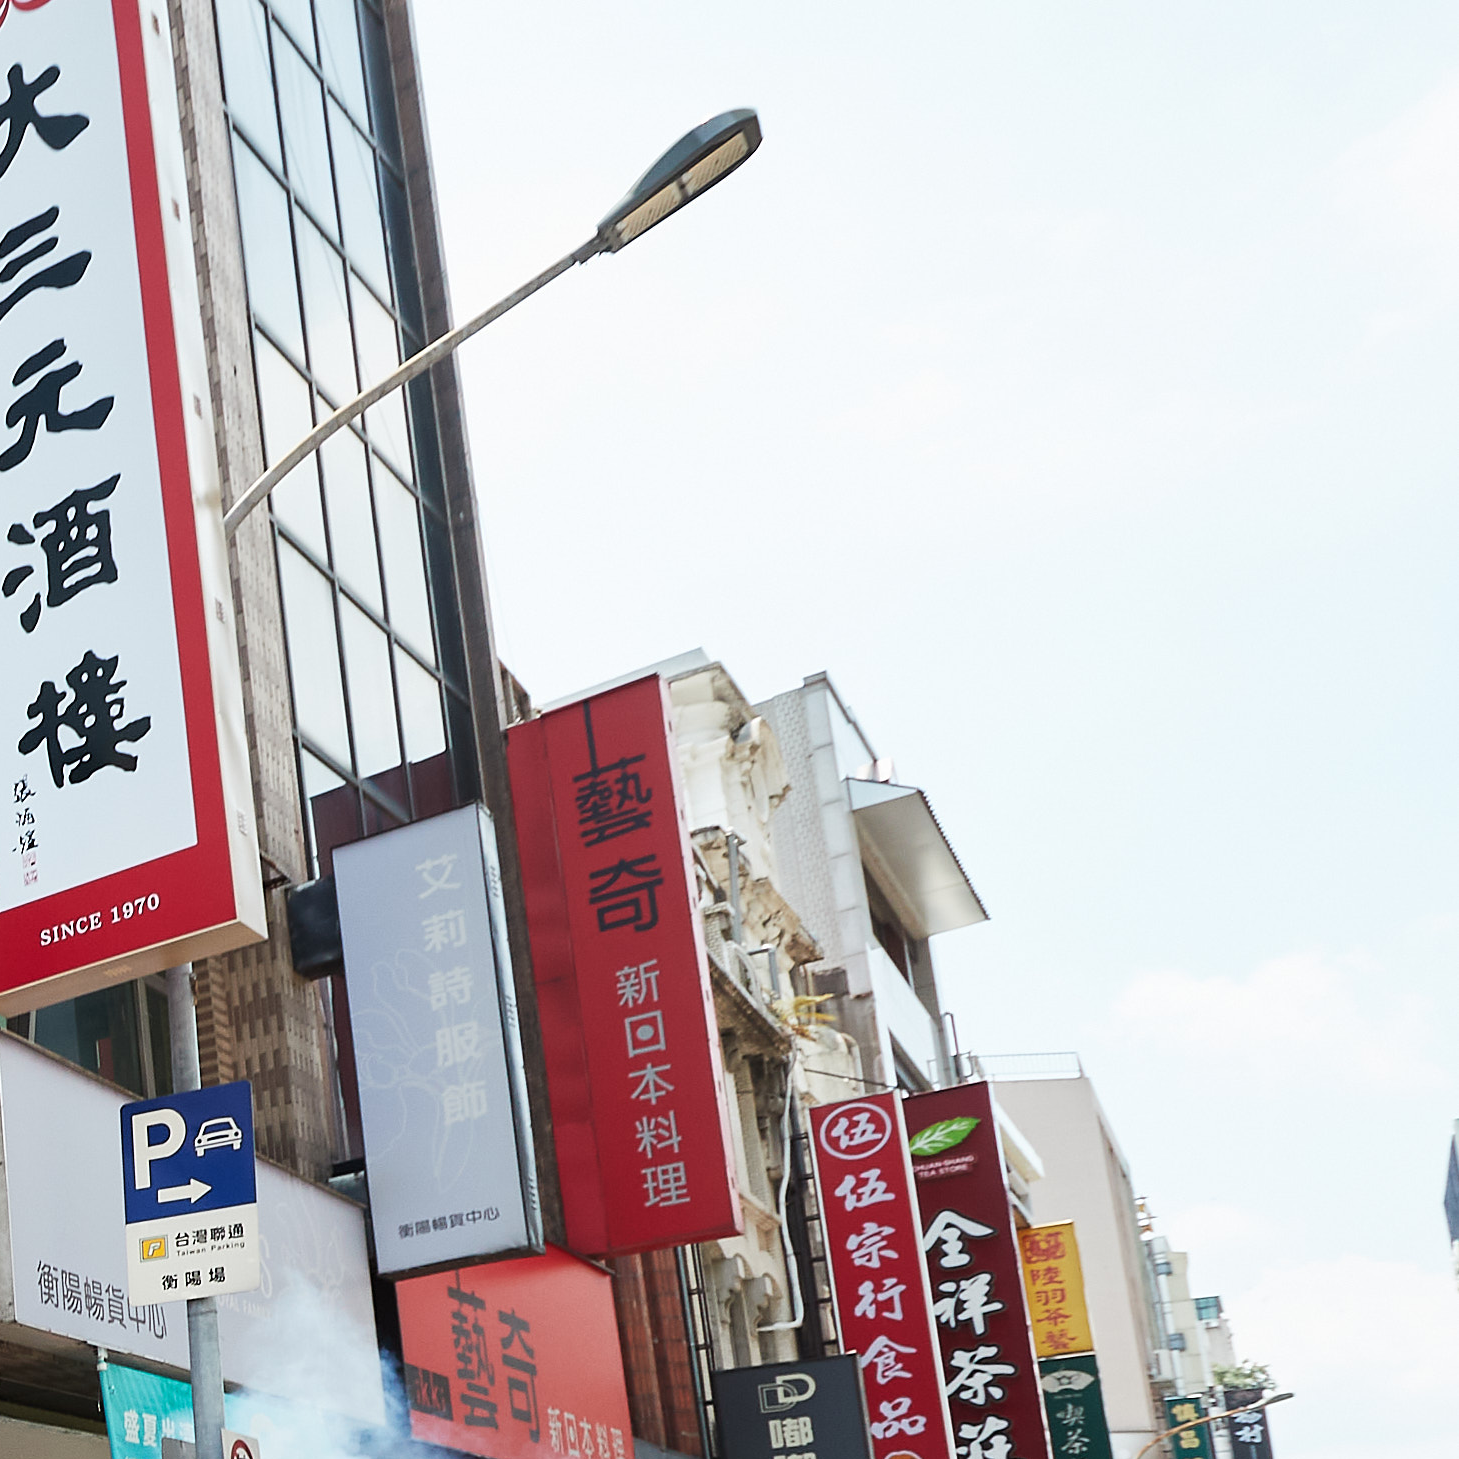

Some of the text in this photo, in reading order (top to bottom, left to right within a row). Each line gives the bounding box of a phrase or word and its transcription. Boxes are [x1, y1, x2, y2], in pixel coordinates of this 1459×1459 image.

[572, 703, 666, 933] 藝奇
[39, 891, 161, 948] SINCE 1970
[415, 853, 489, 1126] 艾莉詩服飾
[132, 1108, 186, 1189] P
[831, 1112, 883, 1150] 伍
[176, 1223, 244, 1247] 台灣聯通
[177, 1240, 245, 1257] Taiwan Parking
[161, 1266, 226, 1291] 衡陽場
[835, 1168, 927, 1440] 伍宗行食品
[447, 1270, 541, 1443] 藝奇
